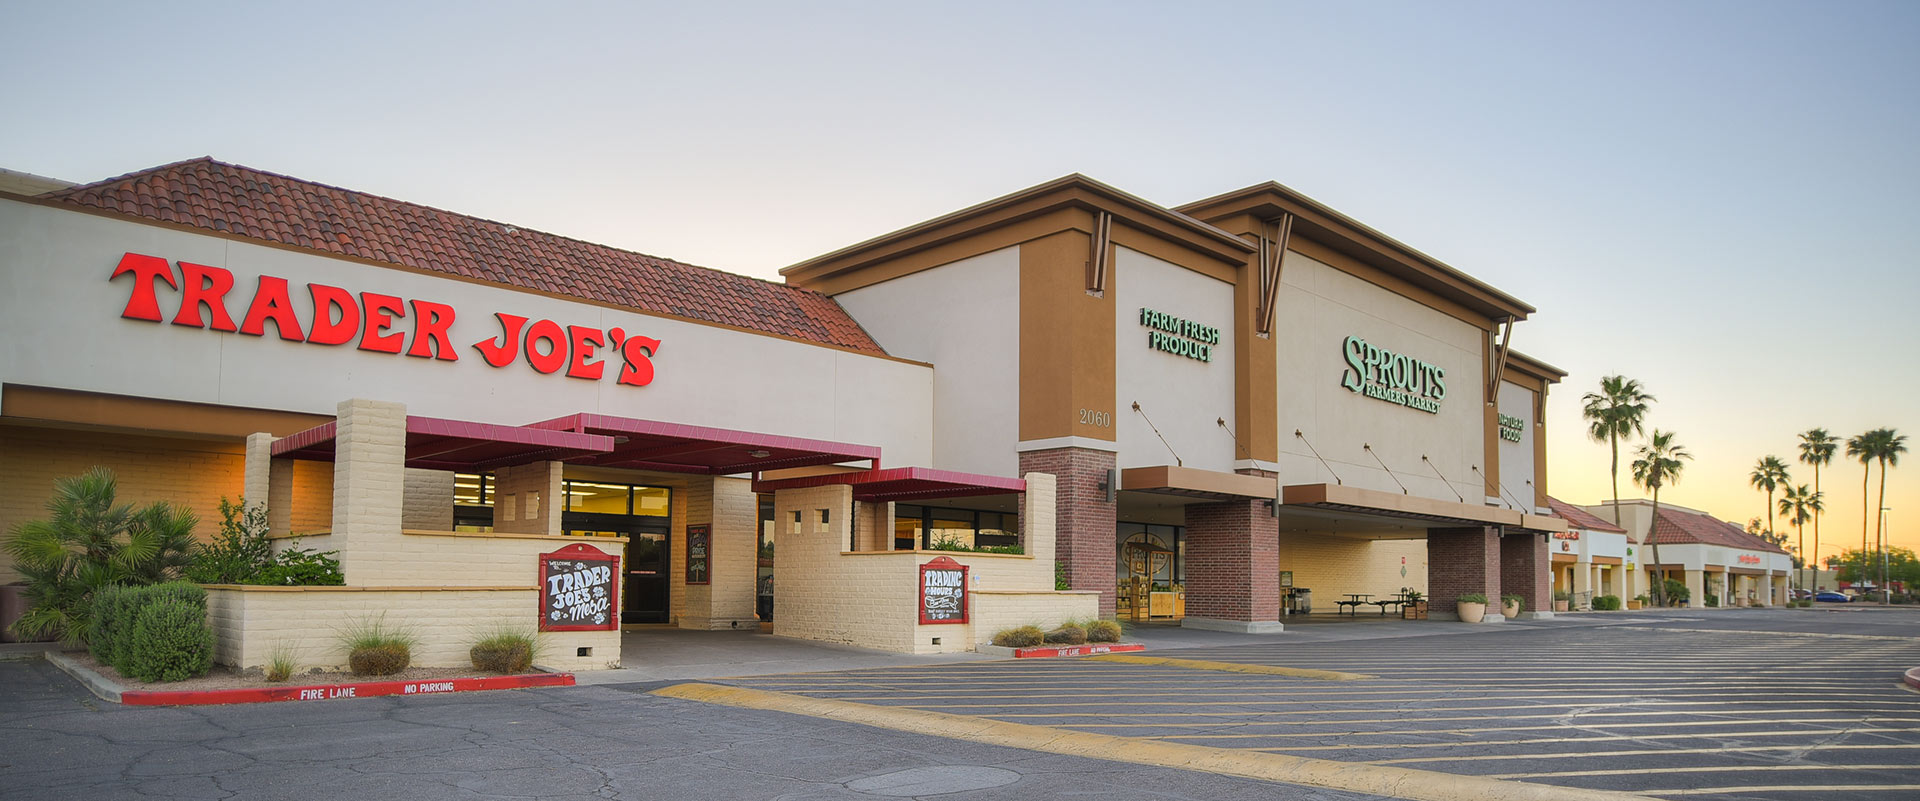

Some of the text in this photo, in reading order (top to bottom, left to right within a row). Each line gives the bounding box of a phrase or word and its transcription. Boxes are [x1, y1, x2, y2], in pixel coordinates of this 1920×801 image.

[109, 252, 662, 387] TRADER JOE'S
[1140, 307, 1220, 345] FARM FRESH
[1149, 331, 1213, 363] PRODUCE
[1341, 335, 1447, 400] SPROUTS
[1363, 383, 1441, 415] FARMERS MARKET
[1080, 408, 1110, 427] 2060
[547, 565, 611, 596] TRADER
[925, 570, 962, 587] TRADING
[930, 586, 953, 595] HOURS
[300, 687, 356, 700] FIRE LANE
[404, 681, 454, 694] NO PARKING
